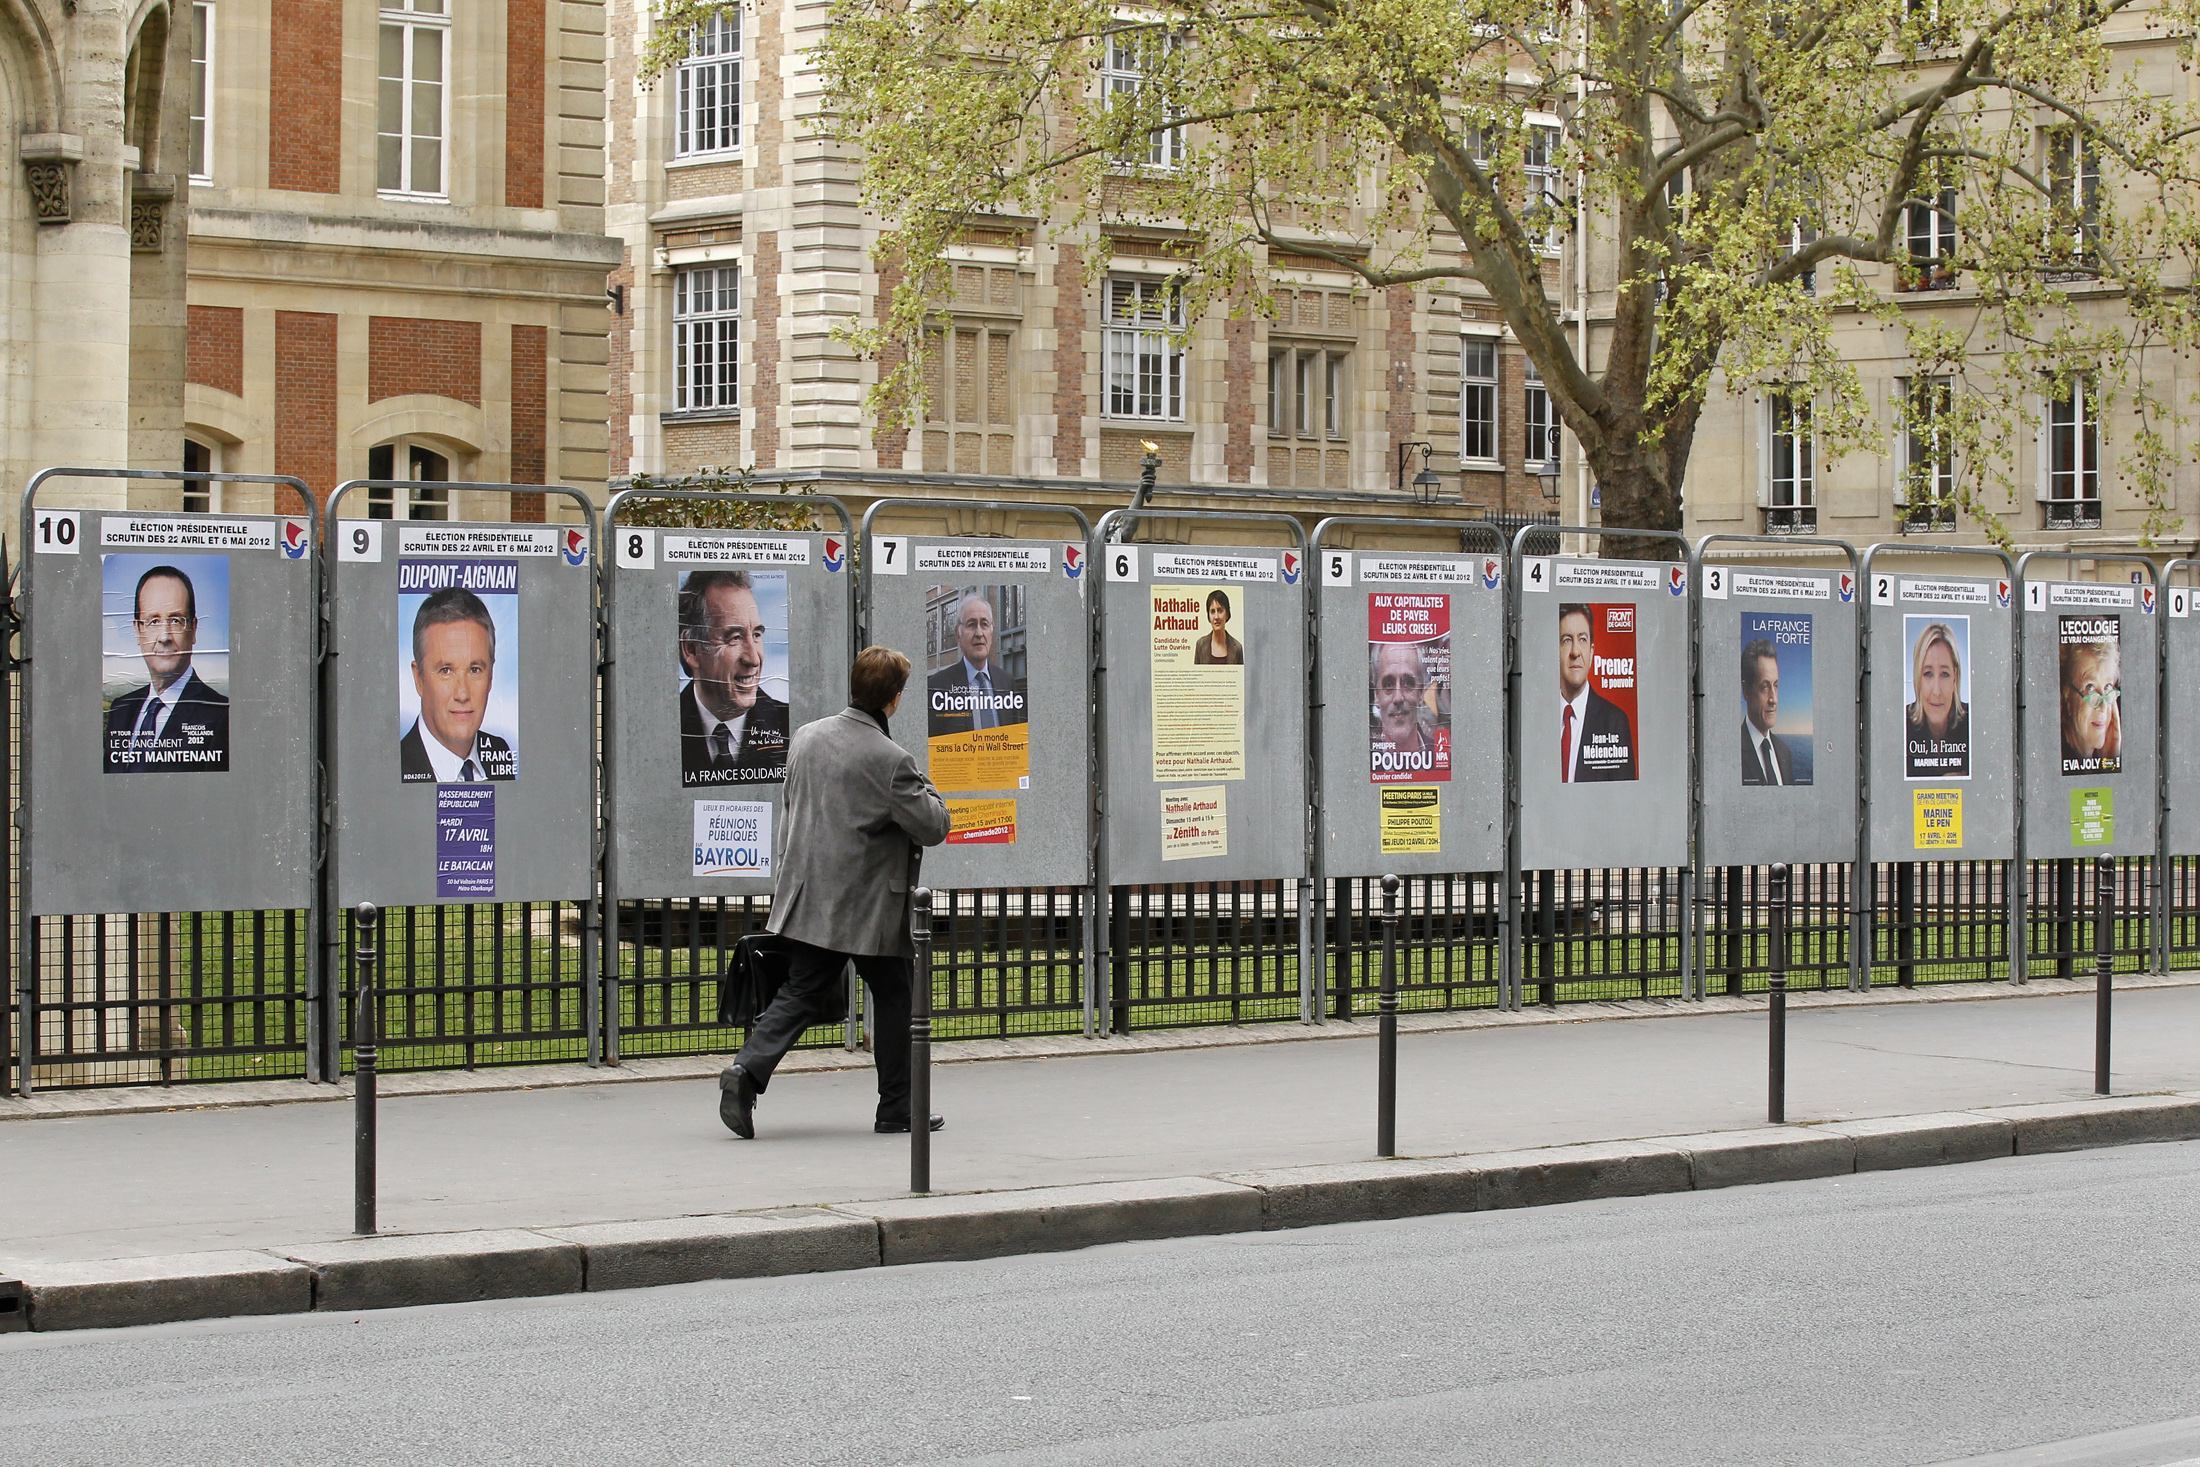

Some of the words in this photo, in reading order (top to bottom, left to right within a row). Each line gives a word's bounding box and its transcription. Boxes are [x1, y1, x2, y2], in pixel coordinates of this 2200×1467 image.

[40, 518, 75, 544] 10
[130, 522, 173, 533] ÉLECTION
[176, 523, 247, 534] PRÉSIDENTIELLE
[107, 534, 145, 543] SCRUTIN
[148, 535, 165, 544] DES
[168, 535, 178, 544] 22
[181, 536, 205, 545] AVRIL
[209, 536, 219, 545] ET
[222, 537, 227, 545] 6
[230, 537, 246, 545] MAI
[249, 537, 269, 546] 2012
[354, 528, 370, 554] 9
[426, 531, 465, 541] ÉLECTION
[468, 533, 532, 542] PRÉSIDENTIELLE
[404, 544, 439, 552] SCRUTIN
[442, 544, 458, 552] DES
[460, 544, 470, 552] 22
[472, 544, 494, 552] AVRIL
[517, 545, 532, 553] MAI
[534, 545, 553, 553] 2012
[628, 534, 643, 558] 8
[689, 541, 724, 549] ÉLECTION
[728, 542, 787, 550] PRÉSIDENTIELLE
[669, 551, 701, 559] SCRUTIN
[703, 552, 718, 560] DES
[720, 552, 729, 560] 22
[754, 553, 763, 561] ET
[766, 553, 770, 561] 6
[772, 553, 786, 561] MAI
[788, 553, 805, 561] 2012
[883, 542, 896, 564] 7
[938, 549, 971, 558] ÉLECTION
[974, 550, 1029, 559] PRÉSIDENTIELLE
[919, 560, 949, 568] SCRUTIN
[1116, 554, 1128, 577] 6
[1174, 557, 1204, 566] ÉLECTION
[1207, 559, 1257, 568] PRÉSIDENTIELLE
[1332, 557, 1342, 577] 5
[400, 564, 517, 589] DUPONT-AIGNAN
[1531, 563, 1542, 582] 4
[1574, 568, 1599, 576] ÉLECTION
[1601, 569, 1643, 577] PRÉSIDENTIELLE
[1711, 571, 1720, 590] 3
[1749, 578, 1773, 586] ÉLECTION
[1878, 578, 1888, 597] 2
[2032, 586, 2038, 604] 1
[1154, 598, 1200, 612] Nathalie
[1375, 596, 1392, 607] AUX
[1394, 596, 1444, 608] CAPITALISTES
[2175, 595, 2183, 613] 0
[1390, 610, 1402, 620] DE
[1404, 610, 1429, 621] PAYER
[1609, 612, 1632, 620] FRONT
[1154, 616, 1199, 630] Arthaud
[1382, 623, 1406, 634] LEURS
[1753, 620, 1766, 630] LA
[1768, 620, 1810, 632] FRANCE
[2061, 620, 2118, 634] L'ECOLOGIE
[1776, 633, 1810, 644] FORTE
[2061, 636, 2068, 644] LE
[2068, 636, 2082, 644] VRAI
[2082, 636, 2118, 644] CHANGEMENT
[1594, 655, 1634, 676] Prenez
[949, 684, 979, 695] Jacques
[1602, 677, 1608, 689] le
[1609, 677, 1634, 690] pouvoir
[932, 691, 1024, 710] Cheminade
[110, 739, 120, 749] LE
[121, 738, 183, 748] CHANGEMENT
[480, 737, 492, 748] LA
[972, 734, 982, 742] Un
[984, 733, 1008, 741] monde
[1592, 733, 1620, 744] Jean-Luc
[936, 744, 952, 752] sans
[954, 744, 960, 752] la
[962, 744, 976, 753] City
[978, 742, 984, 751] ni
[986, 743, 1000, 751] Wall
[1002, 742, 1024, 750] Street
[1372, 742, 1396, 750] PHILIPPE
[1584, 745, 1628, 758] Mélenchon
[1909, 740, 1928, 754] Oui,
[1930, 740, 1938, 752] la
[1940, 740, 1966, 753] France
[110, 751, 142, 763] C'EST
[145, 750, 223, 762] MAINTENANT
[480, 751, 517, 762] FRANCE
[1372, 750, 1432, 771] POUTOU
[1914, 758, 1938, 767] MARINE
[1940, 758, 1948, 766] LE
[1949, 758, 1962, 766] PEN
[2064, 760, 2079, 770] EVA
[2080, 758, 2100, 770] JOLY
[490, 765, 518, 776] LIBRE
[685, 770, 697, 783] LA
[699, 769, 738, 782] FRANCE
[740, 767, 787, 780] SOLIDAIRE
[439, 790, 493, 800] RASSEMBLEMENT
[439, 799, 480, 808] RÉPUBLICAIN
[1166, 803, 1192, 813] Nathalie
[1193, 800, 1218, 810] Arthaud
[1924, 808, 1952, 818] MARINE
[440, 818, 462, 826] MARDI
[710, 815, 757, 830] RÉUNIONS
[1388, 818, 1410, 826] PHILIPPE
[1411, 818, 1432, 826] POUTOU
[1926, 819, 1935, 828] LE
[1937, 819, 1950, 828] PEN
[445, 829, 457, 842] 17
[458, 828, 490, 842] AVRIL
[708, 830, 758, 842] PUBLIQUES
[1174, 826, 1200, 838] Zénith
[480, 844, 493, 853] 18H
[439, 862, 450, 871] LE
[451, 861, 493, 871] BATACLAN
